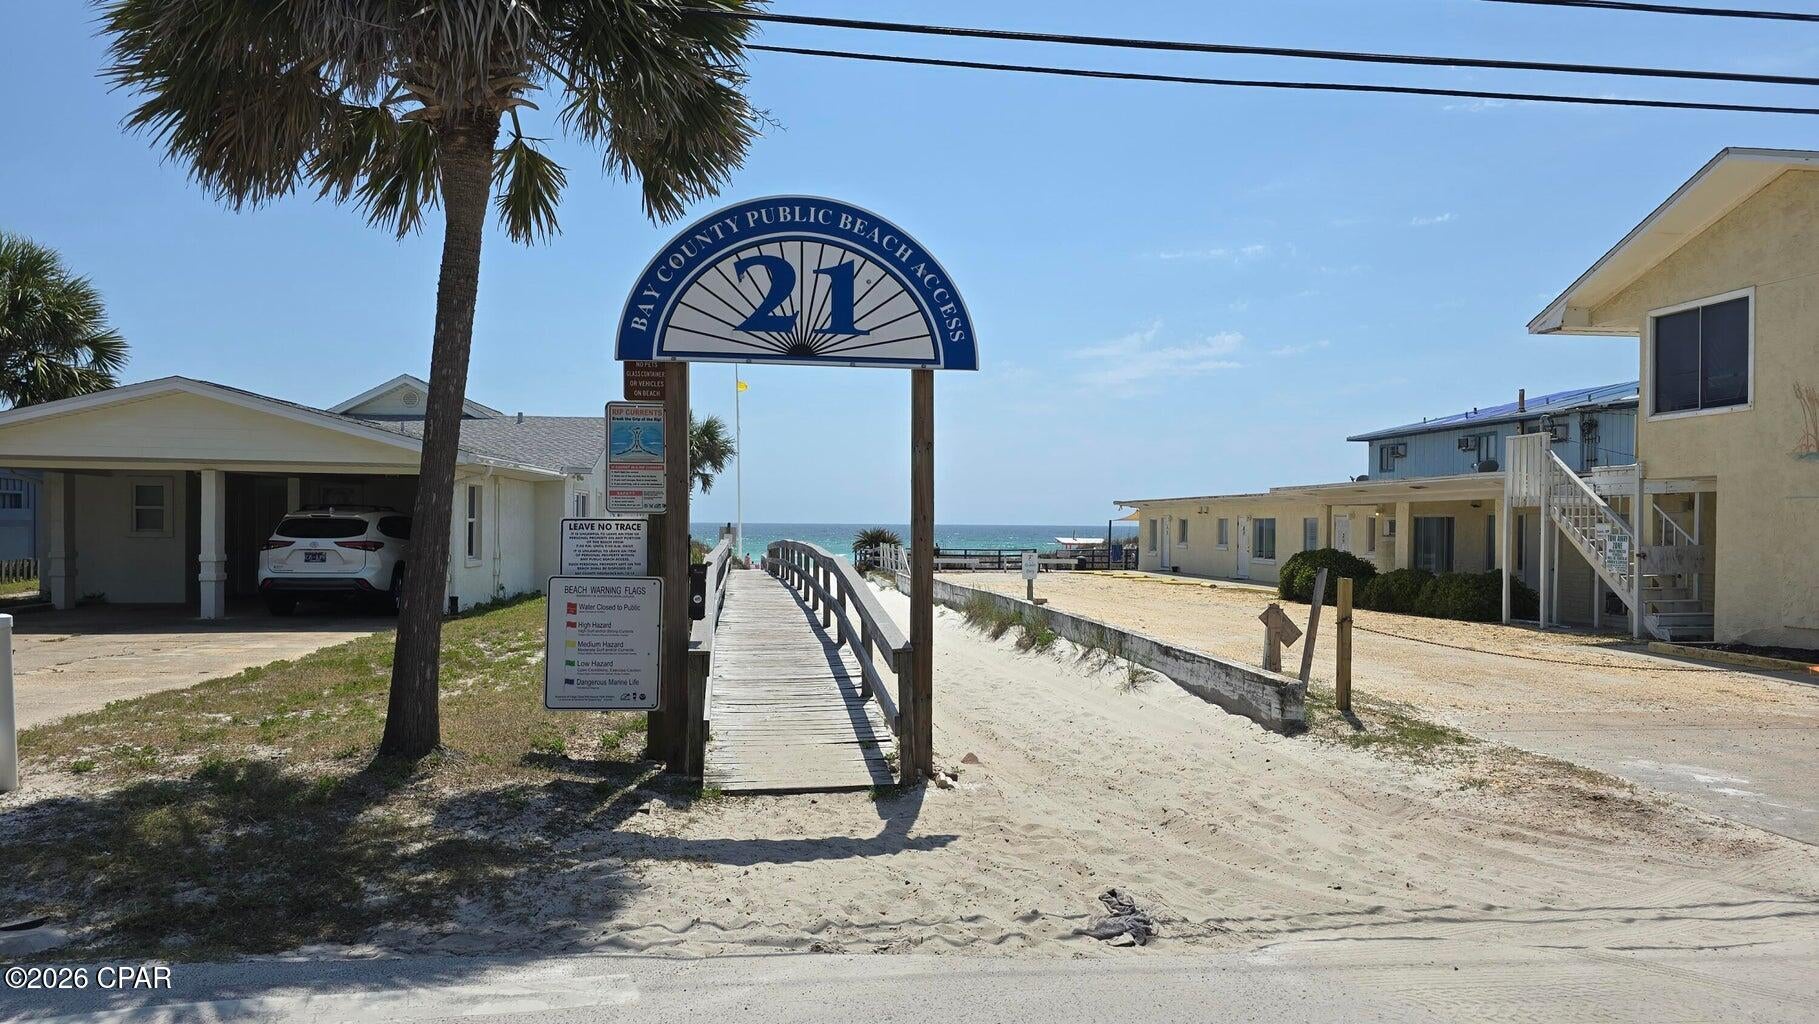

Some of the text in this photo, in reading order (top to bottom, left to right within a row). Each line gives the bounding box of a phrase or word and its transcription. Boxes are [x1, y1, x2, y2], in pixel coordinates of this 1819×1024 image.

[630, 206, 966, 342] BAY COUNTY PUBLIC BEACH ACCESS
[733, 255, 870, 336] 21
[625, 408, 662, 416] CURRENTS
[568, 523, 642, 531] LEAVE NO TRACE
[564, 586, 646, 595] BEACH WARNING FLAGS
